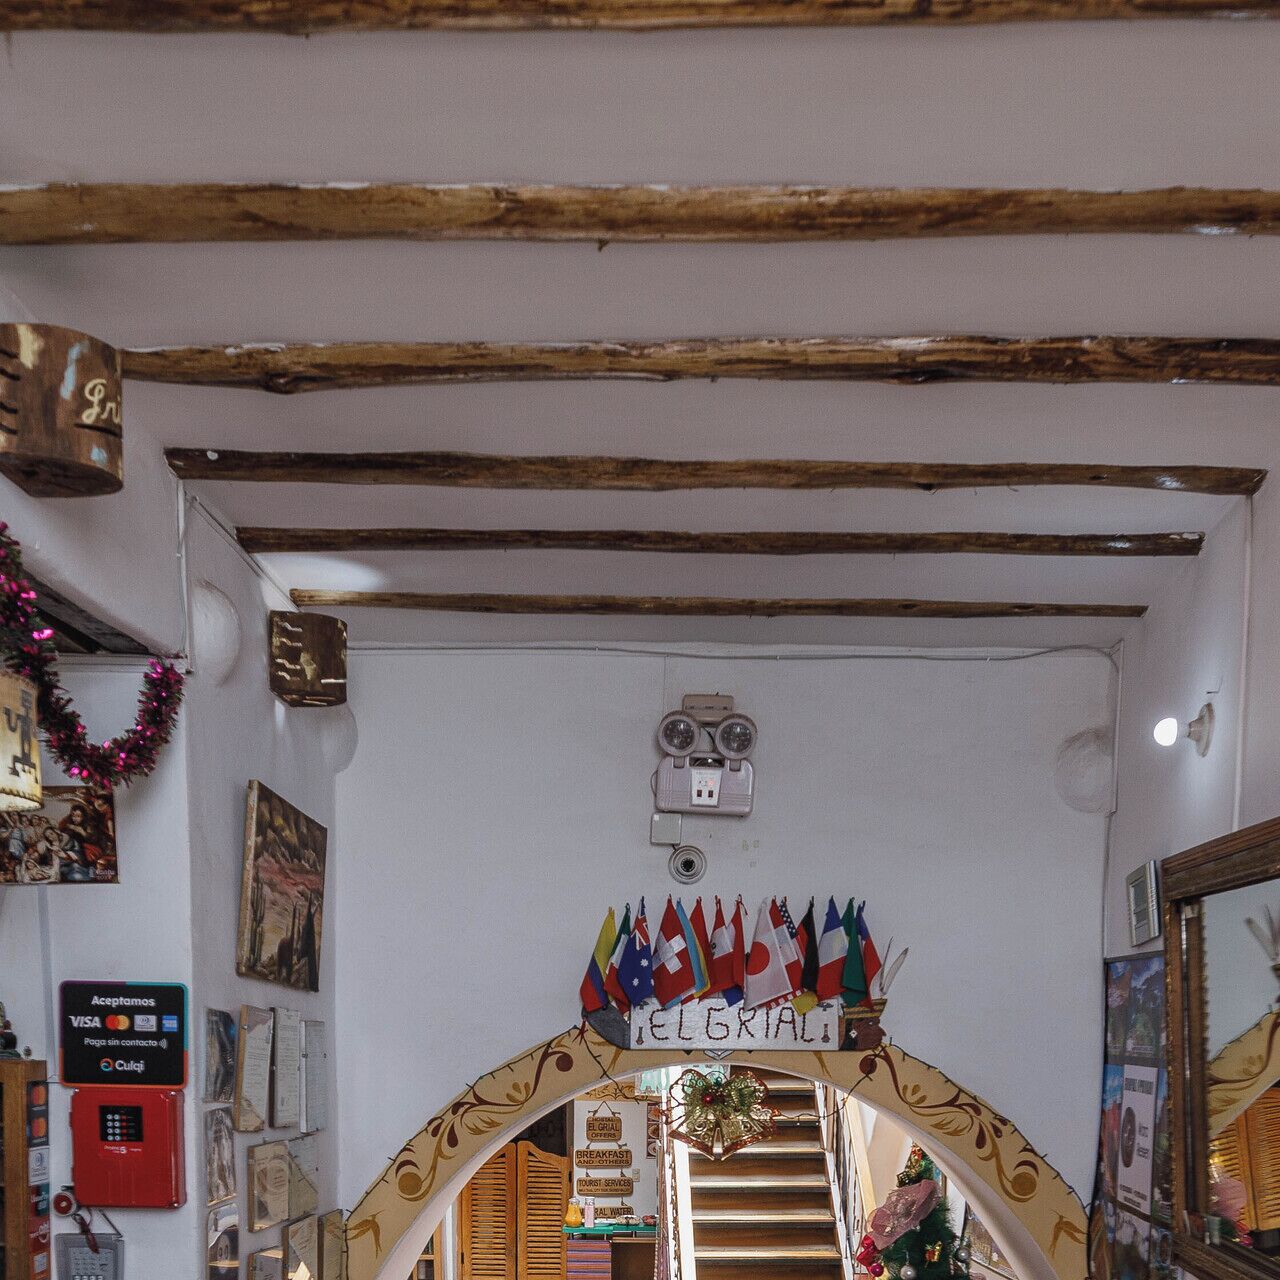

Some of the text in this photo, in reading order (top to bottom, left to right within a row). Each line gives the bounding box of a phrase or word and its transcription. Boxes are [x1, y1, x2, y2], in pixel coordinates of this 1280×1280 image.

[91, 995, 156, 1008] Aceptamos
[69, 1015, 102, 1028] VISA
[650, 1003, 815, 1043] EL GRIAL
[84, 1037, 158, 1048] Paga sin contacto
[115, 1060, 145, 1073] Culqi
[588, 1123, 620, 1132] EL GRIAL
[576, 1150, 629, 1159] BREAKFAST
[579, 1179, 631, 1188] TOURIST SERVICES
